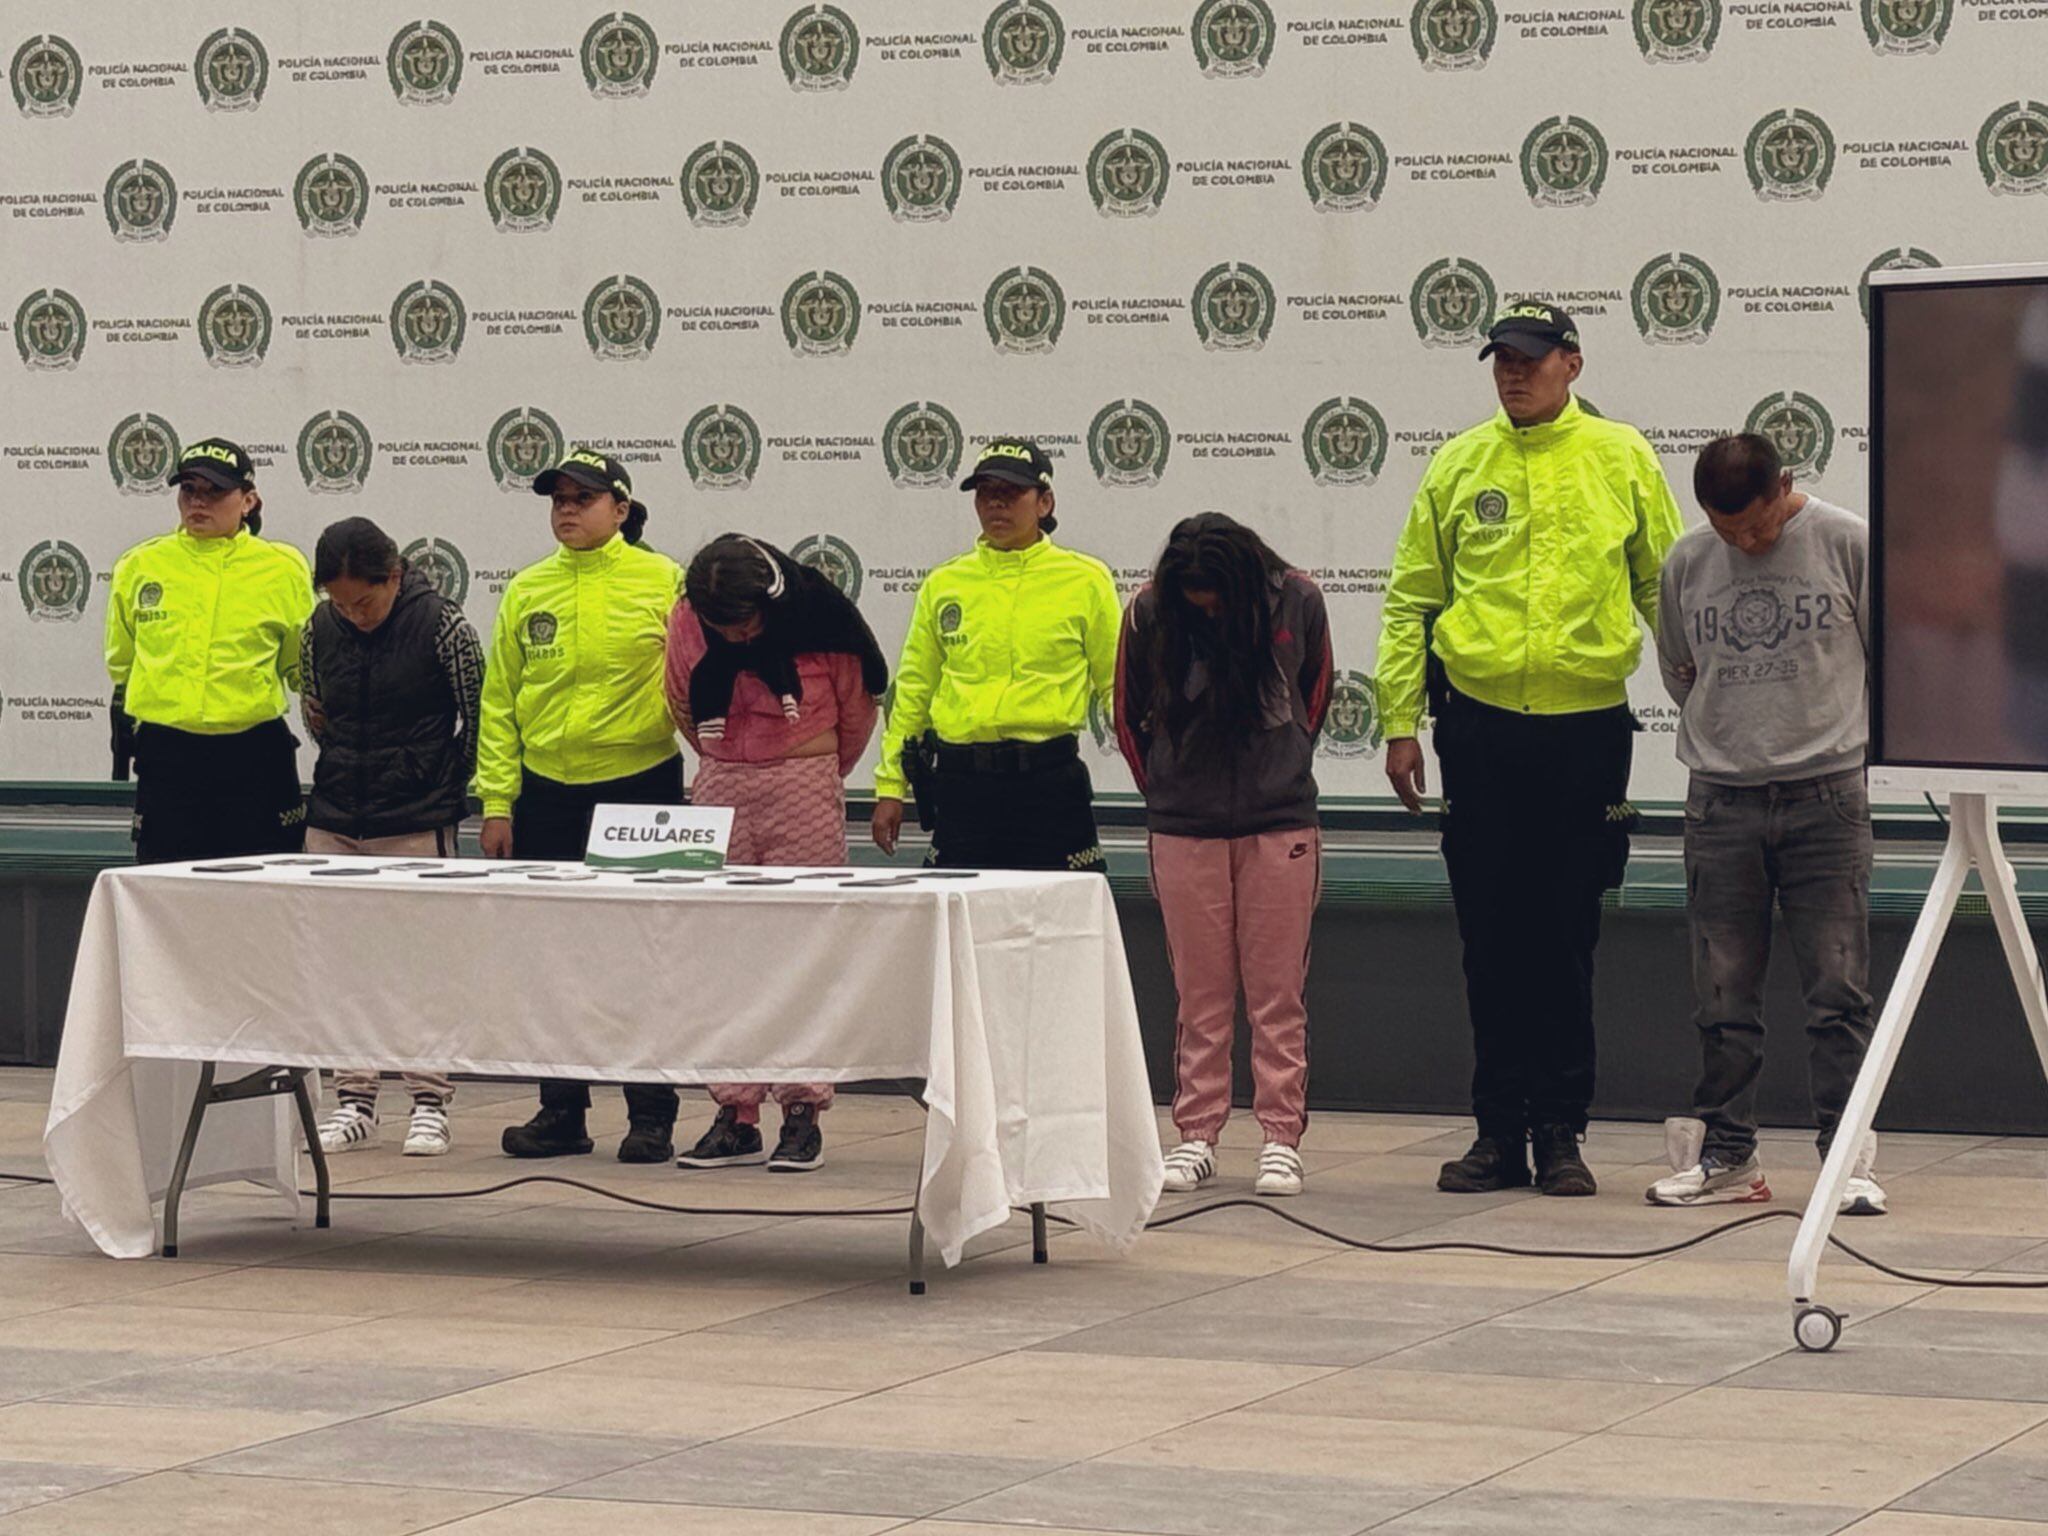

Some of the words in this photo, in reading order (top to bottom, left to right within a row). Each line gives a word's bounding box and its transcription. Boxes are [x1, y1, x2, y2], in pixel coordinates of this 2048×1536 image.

[1783, 0, 1854, 14] NACIONAL
[1557, 9, 1626, 23] NACIONAL
[1978, 9, 1997, 21] DE
[1999, 8, 2048, 20] COLOM
[1337, 17, 1405, 31] NACIONAL
[1745, 17, 1764, 30] DE
[1765, 15, 1837, 30] COLOMBIA
[1121, 25, 1186, 38] NACIONAL
[1520, 26, 1538, 39] DE
[1539, 24, 1609, 38] COLOMBIA
[913, 32, 978, 46] NACIONAL
[1302, 34, 1320, 47] DE
[1321, 32, 1388, 46] COLOMBIA
[712, 40, 774, 53] NACIONAL
[1086, 42, 1103, 54] DE
[1104, 40, 1170, 53] COLOMBIA
[515, 47, 575, 60] NACIONAL
[880, 49, 897, 61] DE
[898, 47, 962, 60] COLOMBIA
[132, 62, 189, 74] NACIONAL
[323, 55, 381, 68] NACIONAL
[679, 56, 696, 69] DE
[696, 54, 759, 68] COLOMBIA
[291, 71, 307, 82] DE
[308, 69, 368, 82] COLOMBIA
[483, 63, 499, 76] DE
[500, 62, 561, 75] COLOMBIA
[101, 78, 117, 89] DE
[118, 76, 176, 88] COLOMBIA
[1897, 139, 1970, 153] NACIONAL
[1446, 152, 1514, 166] NACIONAL
[1668, 146, 1739, 160] NACIONAL
[1226, 158, 1293, 172] NACIONAL
[1631, 163, 1649, 175] DE
[1651, 161, 1722, 175] COLOMBIA
[1859, 156, 1878, 169] DE
[1880, 155, 1952, 168] COLOMBIA
[813, 170, 876, 182] NACIONAL
[1017, 164, 1081, 177] NACIONAL
[1410, 169, 1428, 181] DE
[1429, 167, 1497, 181] COLOMBIA
[614, 175, 675, 189] NACIONAL
[983, 180, 1000, 192] DE
[1001, 178, 1065, 192] COLOMBIA
[1191, 175, 1209, 187] DE
[1210, 173, 1276, 186] COLOMBIA
[226, 187, 285, 199] NACIONAL
[420, 181, 480, 194] NACIONAL
[780, 185, 796, 198] DE
[798, 184, 861, 197] COLOMBIA
[42, 192, 99, 204] NACIONAL
[388, 197, 404, 208] DE
[405, 196, 466, 208] COLOMBIA
[581, 191, 598, 203] DE
[599, 190, 660, 202] COLOMBIA
[12, 207, 27, 219] DE
[28, 206, 85, 218] COLOMBIA
[196, 202, 212, 214] DE
[212, 201, 271, 213] COLOMBIA
[1556, 289, 1623, 302] NACIONAL
[1781, 285, 1851, 298] NACIONAL
[1121, 297, 1186, 310] NACIONAL
[1337, 293, 1405, 307] NACIONAL
[714, 305, 776, 318] NACIONAL
[915, 301, 978, 314] NACIONAL
[1566, 305, 1607, 316] OMBIA
[1743, 301, 1762, 314] DE
[1763, 300, 1835, 313] COLOMBIA
[326, 313, 385, 326] NACIONAL
[517, 309, 578, 322] NACIONAL
[1087, 313, 1104, 325] DE
[1105, 312, 1170, 324] COLOMBIA
[1302, 309, 1320, 321] DE
[1321, 308, 1388, 321] COLOMBIA
[136, 317, 192, 329] NACIONAL
[681, 320, 697, 332] DE
[698, 319, 760, 332] COLOMBIA
[881, 316, 898, 328] DE
[899, 315, 963, 328] COLOMBIA
[295, 328, 310, 339] DE
[312, 327, 371, 339] COLOMBIA
[486, 324, 502, 336] DE
[503, 323, 564, 336] COLOMBIA
[105, 332, 121, 343] DE
[122, 331, 179, 343] COLOMBIA
[616, 438, 676, 449] NACIONAL
[814, 436, 876, 448] NACIONAL
[1226, 432, 1292, 444] NACIONAL
[46, 445, 102, 457] NACIONAL
[423, 441, 483, 452] NACIONAL
[1192, 446, 1209, 459] DE
[1210, 446, 1277, 458] COLOMBIA
[1410, 445, 1428, 456] DE
[391, 455, 407, 466] DE
[408, 454, 469, 466] COLOMBIA
[782, 450, 799, 462] DE
[799, 450, 862, 461] COLOMBIA
[16, 459, 32, 470] DE
[33, 459, 90, 470] COLOMBIA
[883, 582, 899, 592] DE
[1321, 583, 1387, 593] COLOMBIA
[1795, 593, 1832, 630] 52
[1717, 664, 1750, 681] PIER
[50, 697, 107, 709] NACIONAL
[20, 710, 36, 721] DE
[36, 710, 94, 721] COLOMBIA
[603, 826, 716, 844] CELULARES
